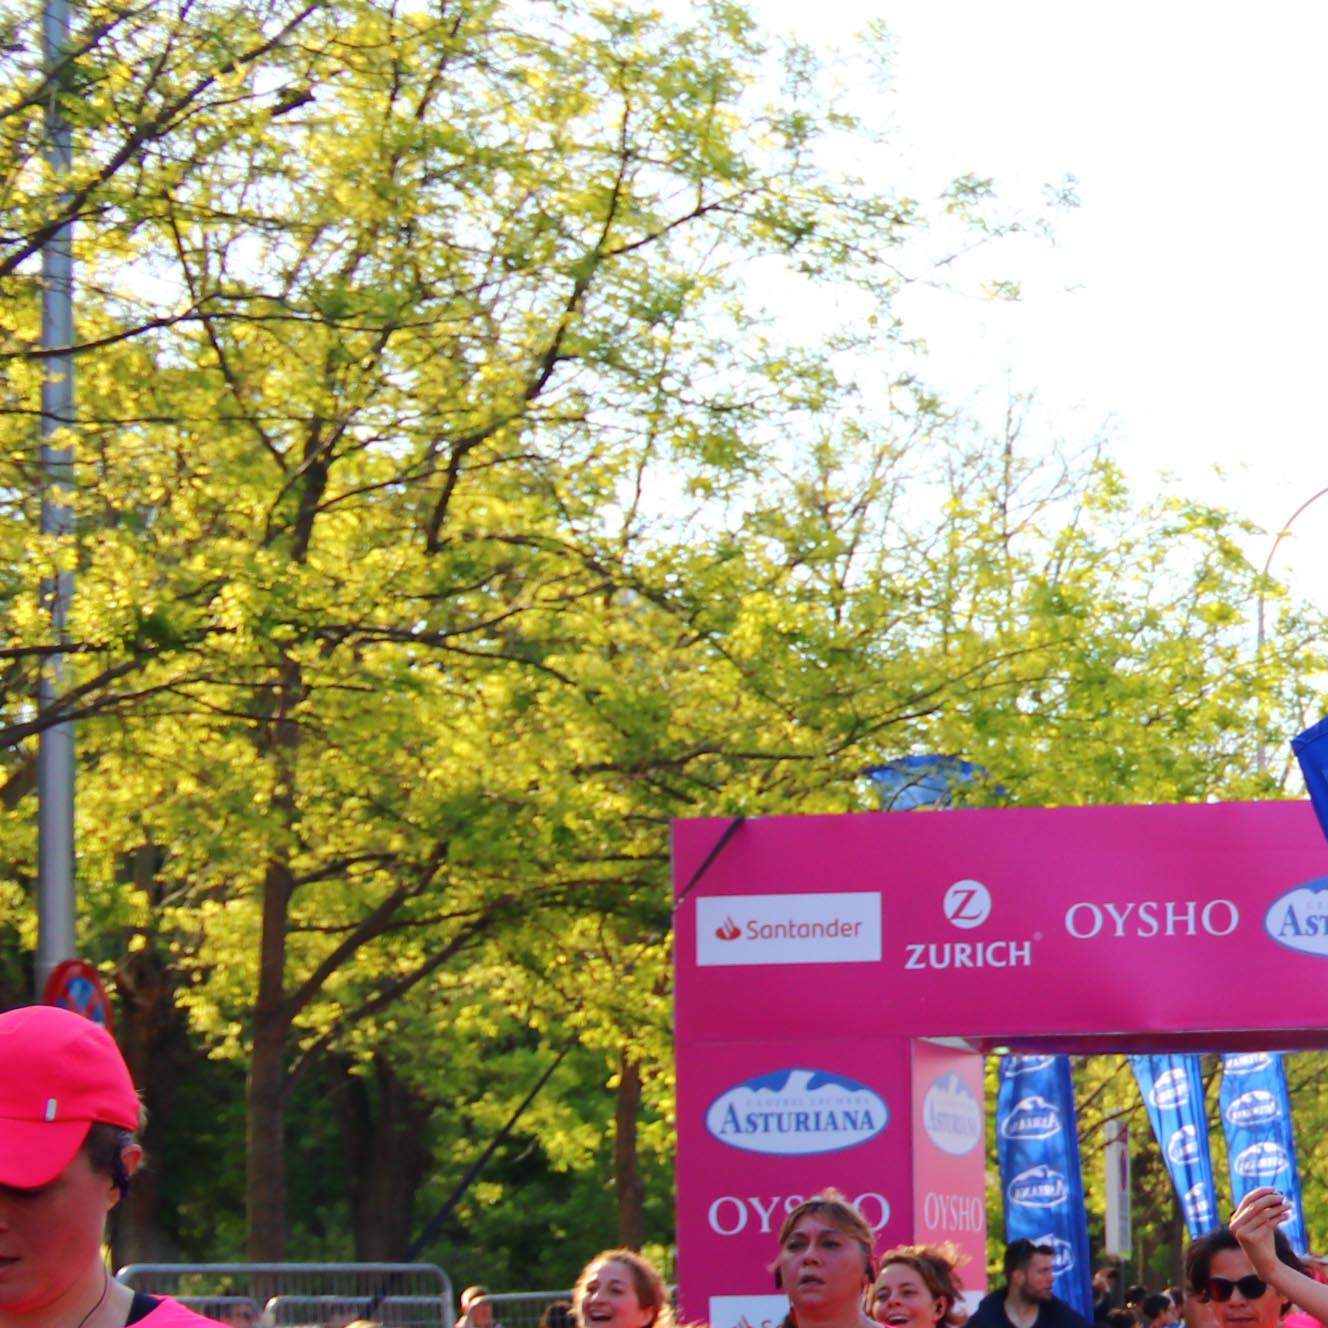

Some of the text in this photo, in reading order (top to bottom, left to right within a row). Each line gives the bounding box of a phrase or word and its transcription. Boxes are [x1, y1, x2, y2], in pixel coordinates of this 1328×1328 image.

[746, 917, 862, 942] Santander
[1065, 899, 1240, 941] OYSHO
[904, 940, 1032, 971] ZURICH
[720, 1101, 875, 1134] ASTURIANA
[708, 1192, 891, 1237] OYO
[924, 1193, 983, 1233] OYSHO
